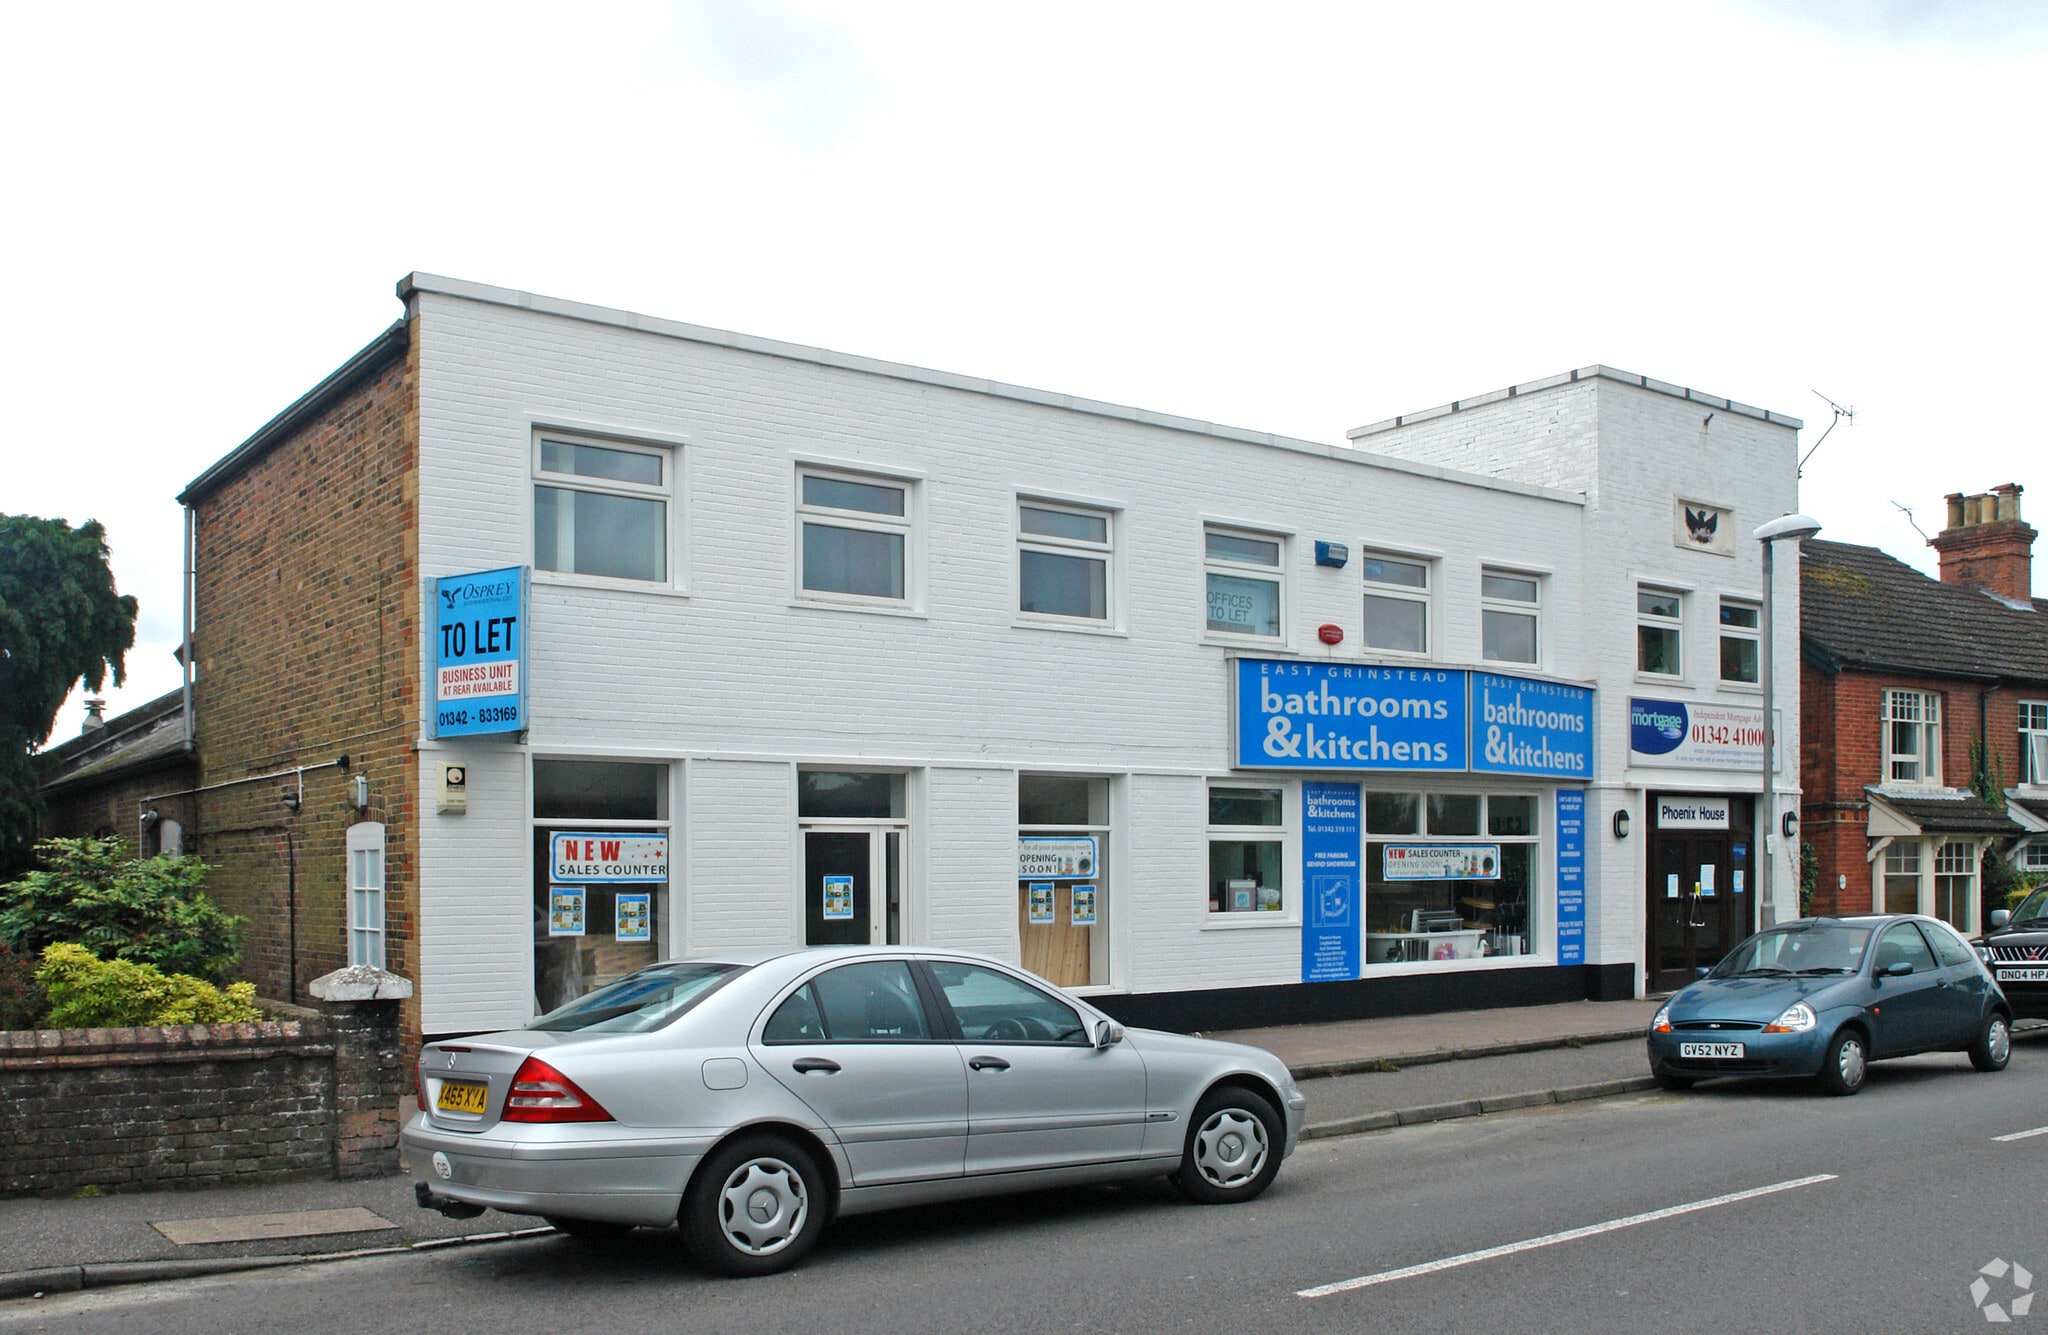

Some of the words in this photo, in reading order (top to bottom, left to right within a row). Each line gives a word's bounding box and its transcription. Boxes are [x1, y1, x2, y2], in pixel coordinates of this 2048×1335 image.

[463, 581, 515, 600] OSPREY
[1206, 591, 1253, 610] OFFICES
[1210, 606, 1225, 619] TO
[1228, 608, 1249, 623] LET
[441, 622, 466, 658] TO
[475, 616, 517, 655] LET
[442, 667, 487, 684] BUSINESS
[489, 664, 513, 679] UNIT
[1261, 663, 1313, 676] EAST
[1328, 667, 1447, 683] GRINSTEAD
[443, 686, 453, 697] AT
[454, 684, 471, 696] REAR
[472, 680, 513, 694] AVAILABLE
[1484, 676, 1513, 690] EAST
[1520, 682, 1584, 700] GRINSTEAD
[1261, 676, 1448, 720] bathrooms
[439, 710, 468, 727] 01342
[479, 706, 518, 723] 833169
[1484, 688, 1584, 733] bathrooms
[1693, 709, 1726, 721] Independent
[1726, 712, 1752, 724] Mortgage
[1631, 711, 1682, 732] mortgage
[1691, 724, 1729, 745] 01342
[1307, 794, 1356, 806] bathrooms
[1661, 805, 1696, 820] Phoenix
[1699, 806, 1725, 821] House
[565, 840, 621, 861] NEW
[1019, 854, 1057, 863] OPENING
[1388, 848, 1406, 859] NEW
[1408, 849, 1429, 858] SALES
[1429, 849, 1461, 858] COUNTER
[559, 864, 600, 875] SALES
[604, 864, 666, 875] COUNTER
[1022, 865, 1057, 874] SOON!
[1388, 860, 1420, 869] OPENING
[2001, 970, 2028, 980] DN04
[1684, 1045, 1711, 1056] GV52
[1714, 1045, 1738, 1056] NYZ
